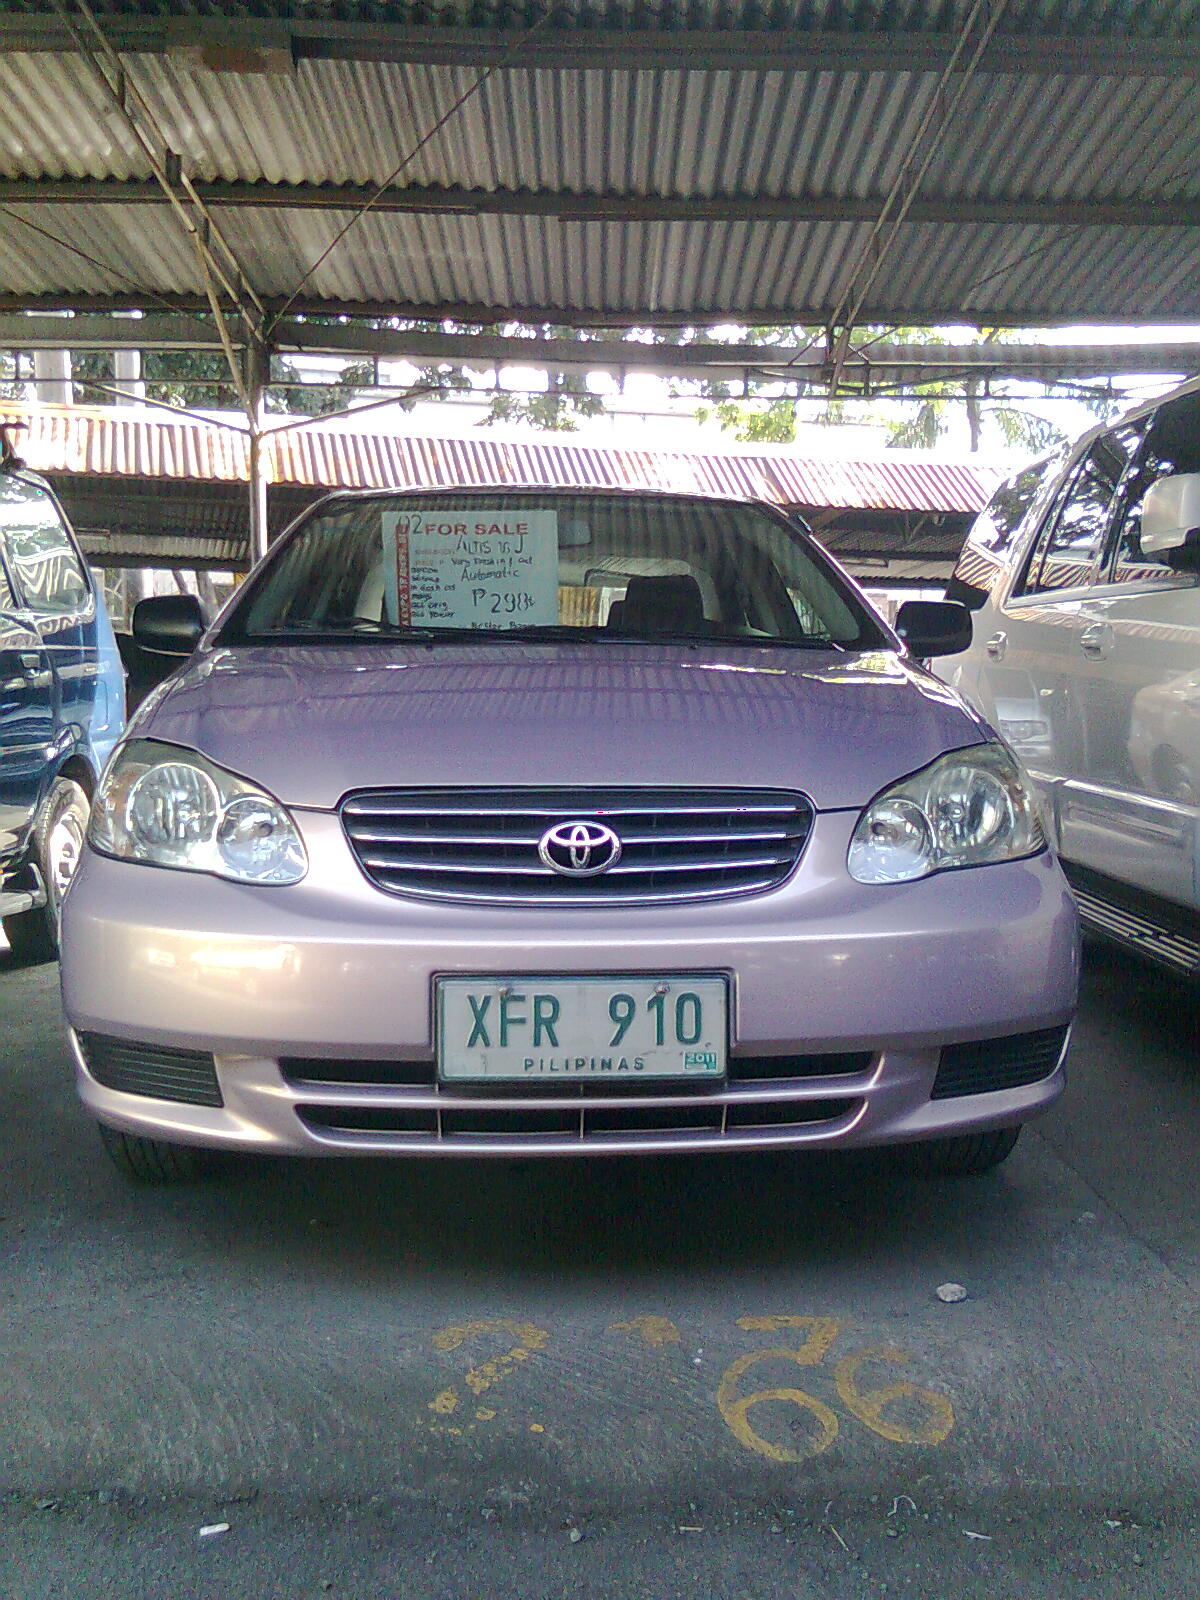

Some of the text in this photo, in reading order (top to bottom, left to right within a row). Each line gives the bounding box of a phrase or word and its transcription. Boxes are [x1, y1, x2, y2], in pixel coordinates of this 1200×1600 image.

[425, 523, 528, 535] FOR SALE
[461, 567, 519, 582] Automatic
[467, 992, 702, 1047] XFR 910
[524, 1057, 645, 1071] PILIPINAS
